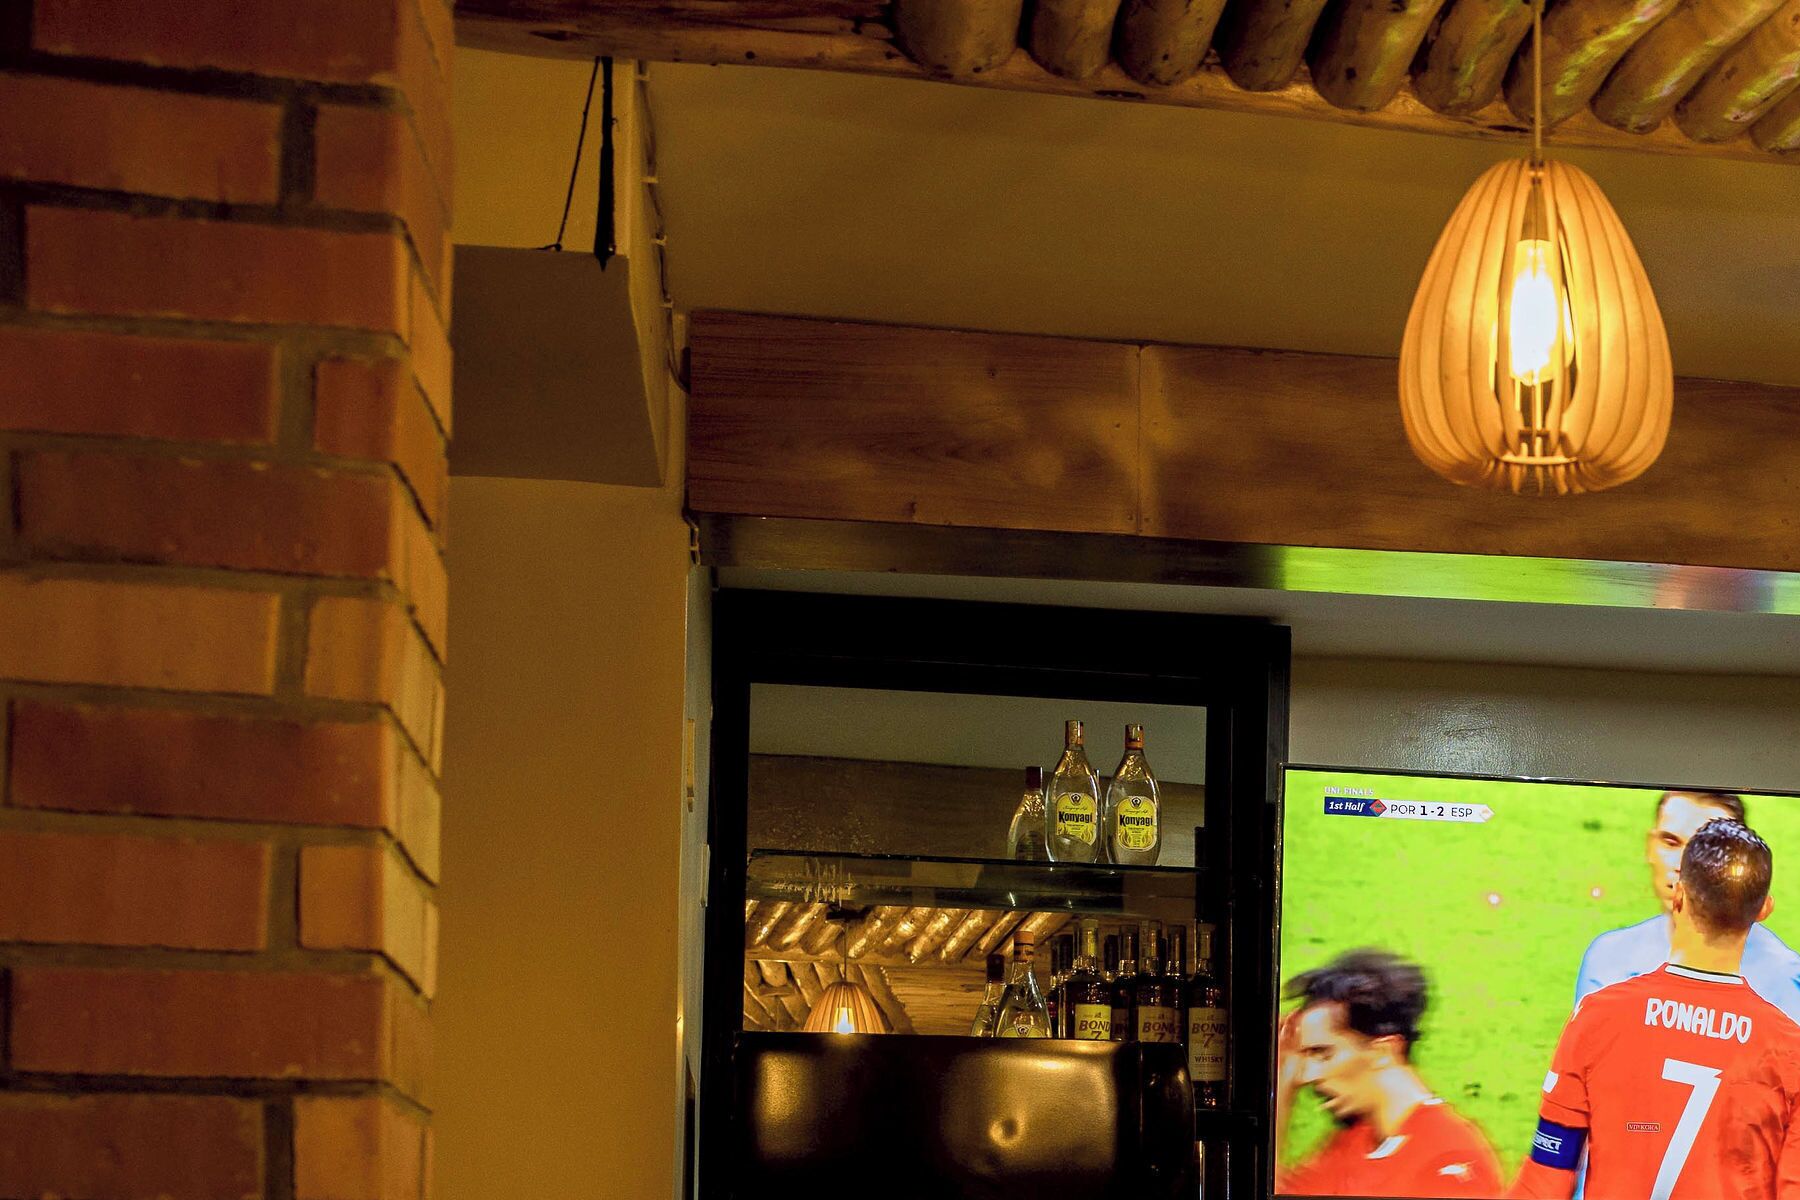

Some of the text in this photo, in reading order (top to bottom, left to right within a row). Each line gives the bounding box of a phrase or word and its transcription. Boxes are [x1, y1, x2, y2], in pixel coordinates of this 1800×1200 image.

[1329, 801, 1366, 813] 1st Half
[1390, 804, 1417, 816] POR
[1451, 807, 1474, 818] ESP
[1058, 811, 1093, 823] Konyagi
[1119, 814, 1153, 826] Konyagi
[1645, 997, 1752, 1044] RONALDO
[1194, 1055, 1224, 1064] WHISKY
